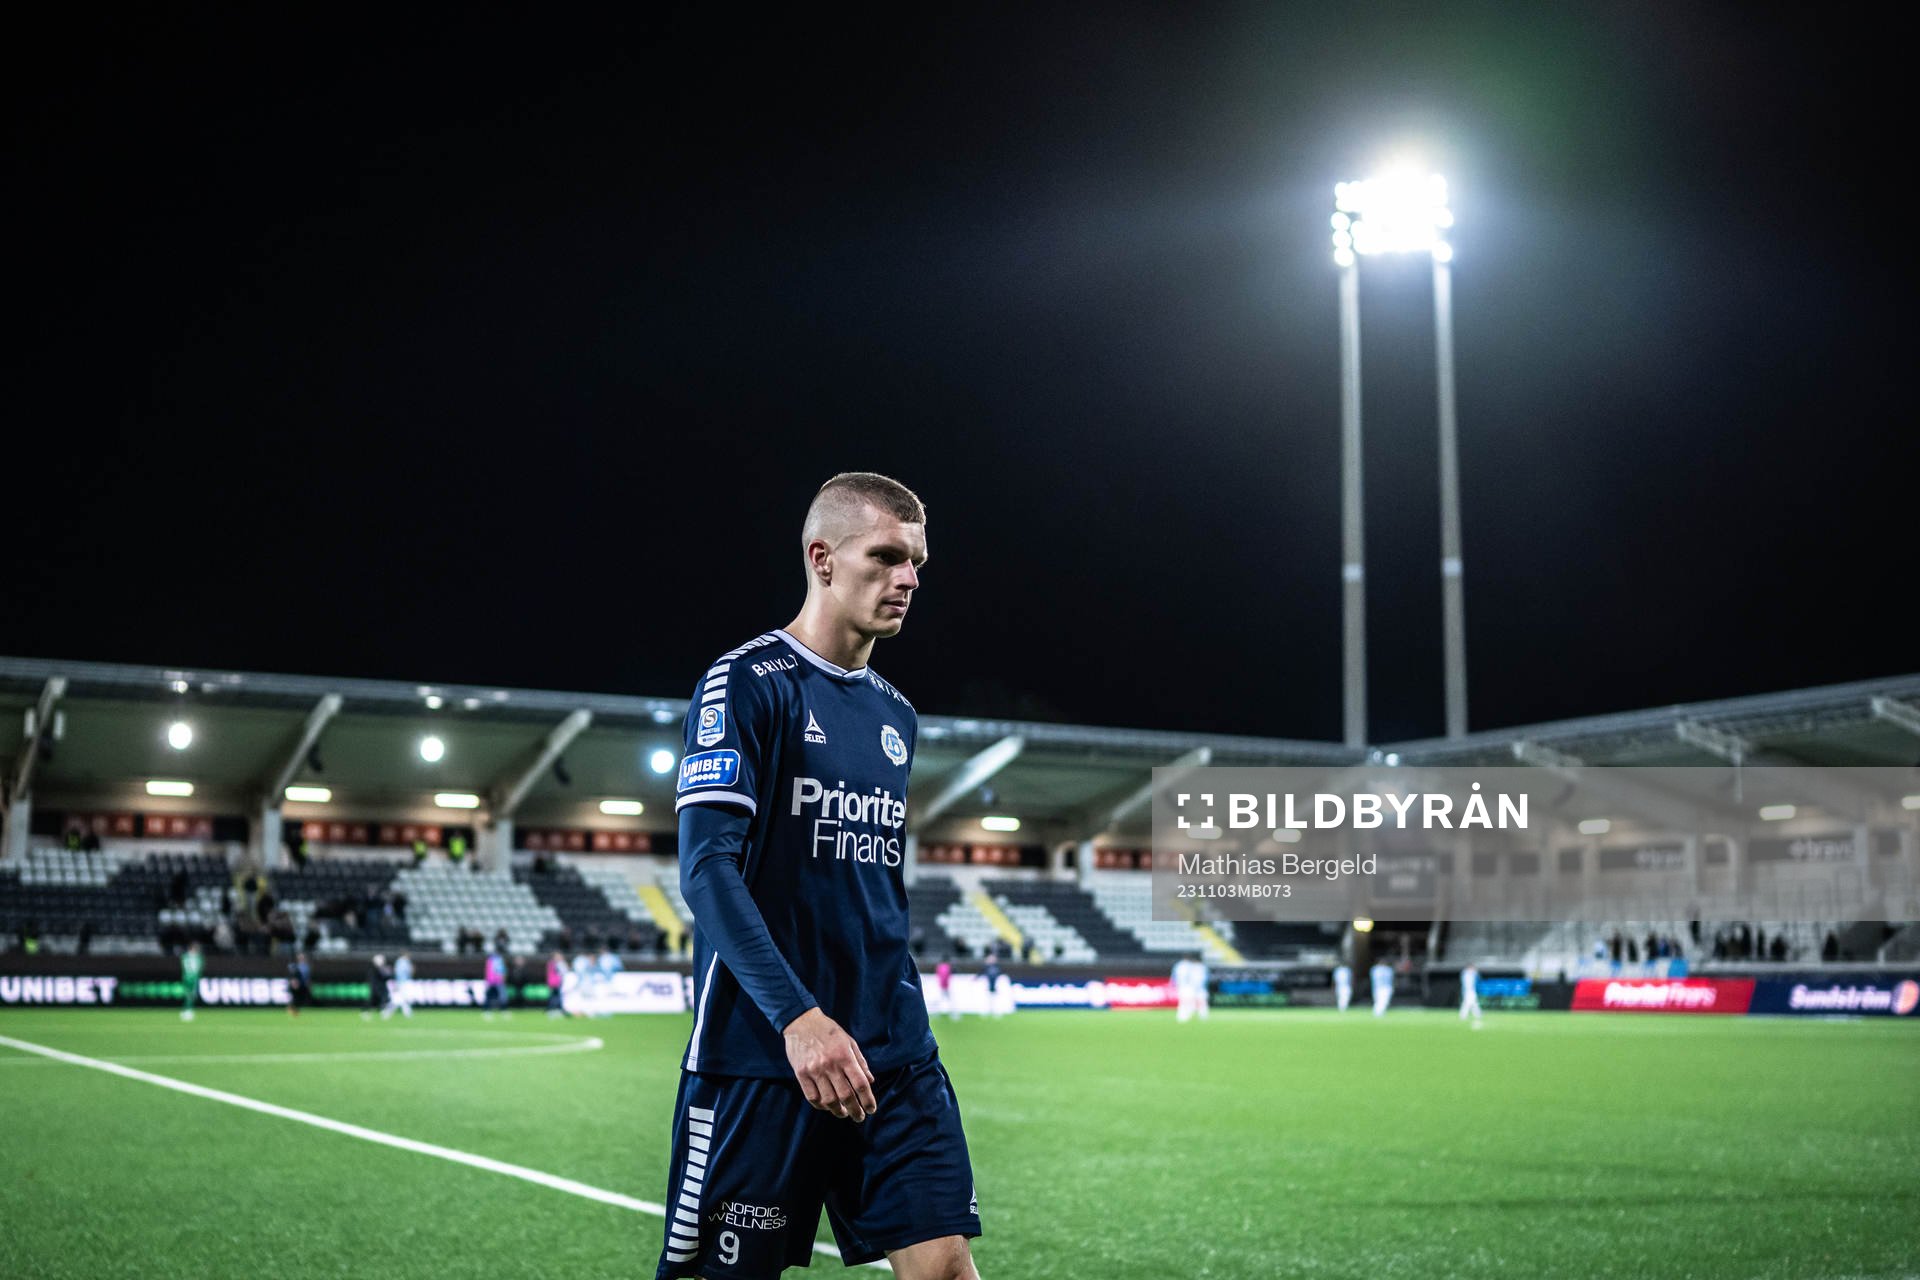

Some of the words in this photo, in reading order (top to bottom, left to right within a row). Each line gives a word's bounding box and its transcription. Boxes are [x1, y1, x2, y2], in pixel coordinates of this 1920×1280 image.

[804, 732, 827, 745] SELECT
[683, 757, 735, 778] UNIBET
[791, 777, 907, 829] Priorite
[812, 819, 901, 867] Finans
[0, 976, 117, 1003] UNIBET
[199, 977, 293, 1003] UNIBE
[708, 1212, 787, 1230] WELLNESS
[722, 1201, 780, 1218] NORDIC
[718, 1230, 740, 1265] 9
